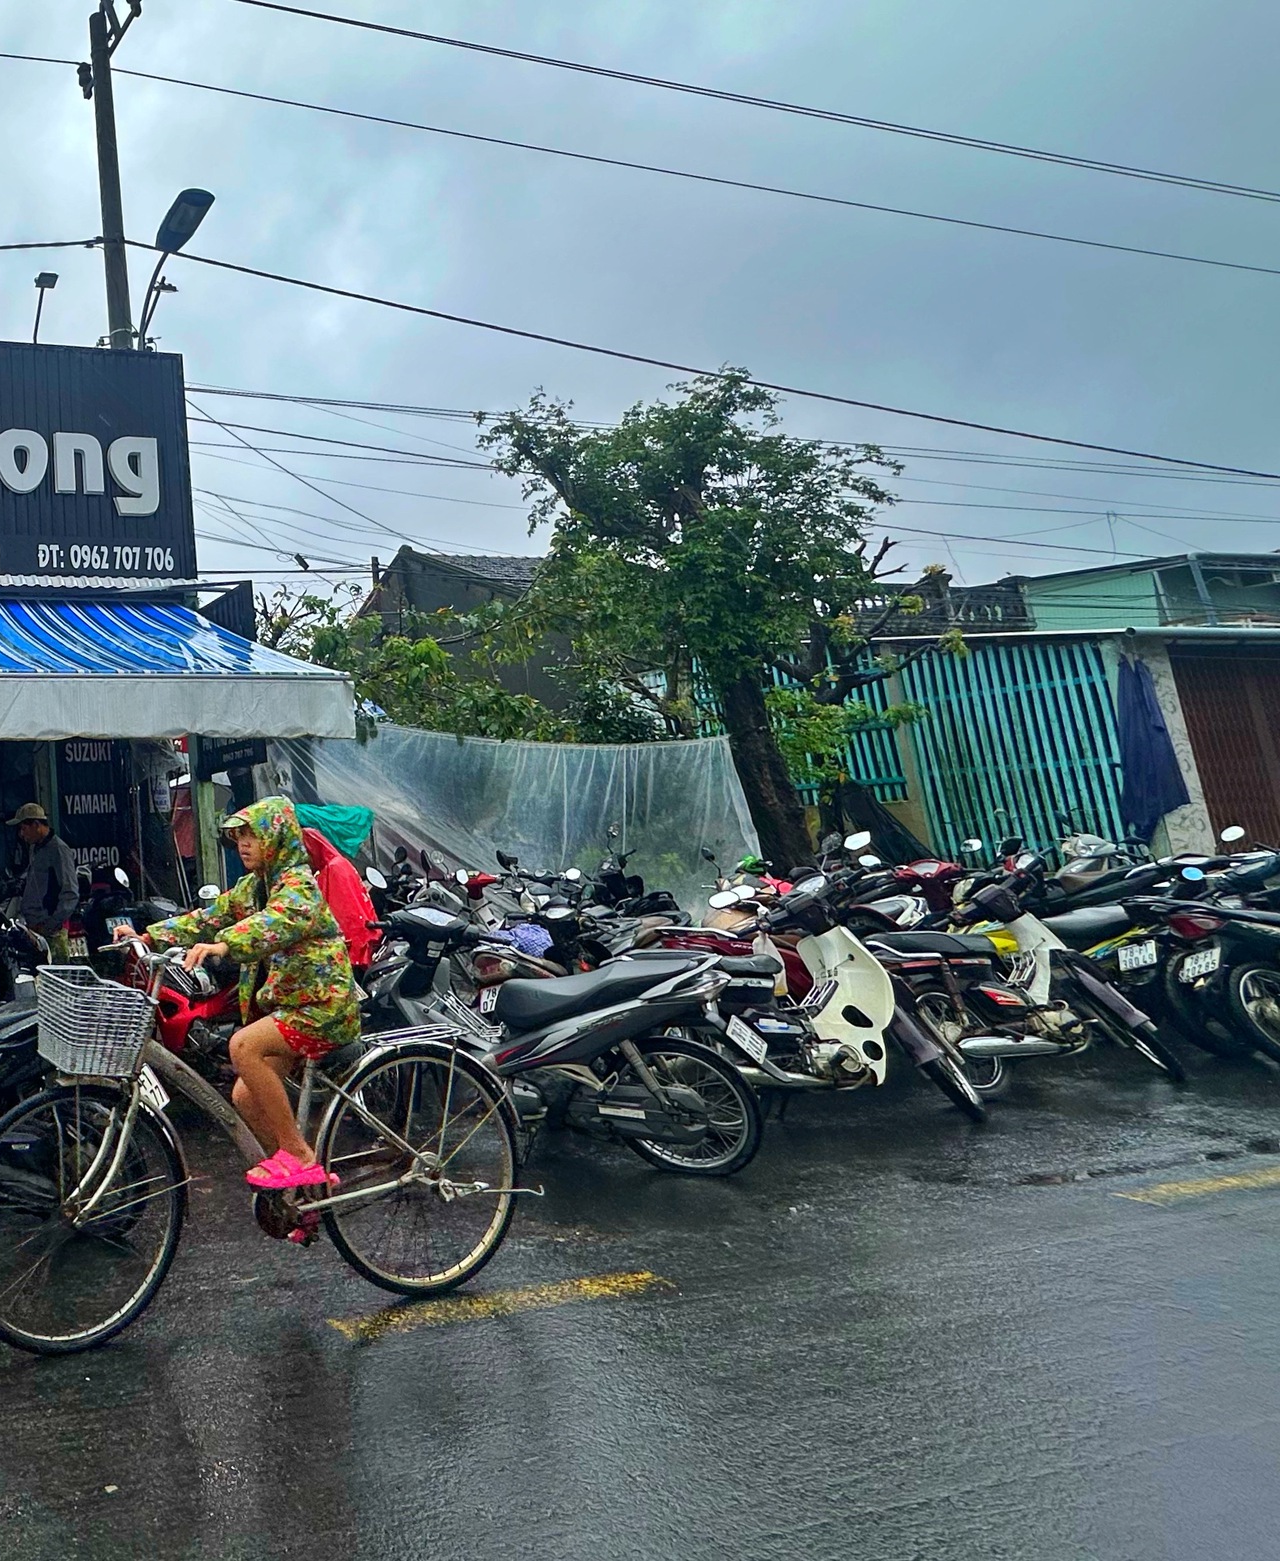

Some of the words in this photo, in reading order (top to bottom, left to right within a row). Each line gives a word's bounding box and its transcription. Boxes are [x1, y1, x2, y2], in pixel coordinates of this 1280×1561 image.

[37, 543, 65, 568] ĐT:
[70, 544, 109, 570] 0962
[113, 545, 141, 571] 707
[145, 547, 174, 572] 706
[65, 742, 111, 762] SUZUKI
[65, 794, 117, 815] YAMAHA
